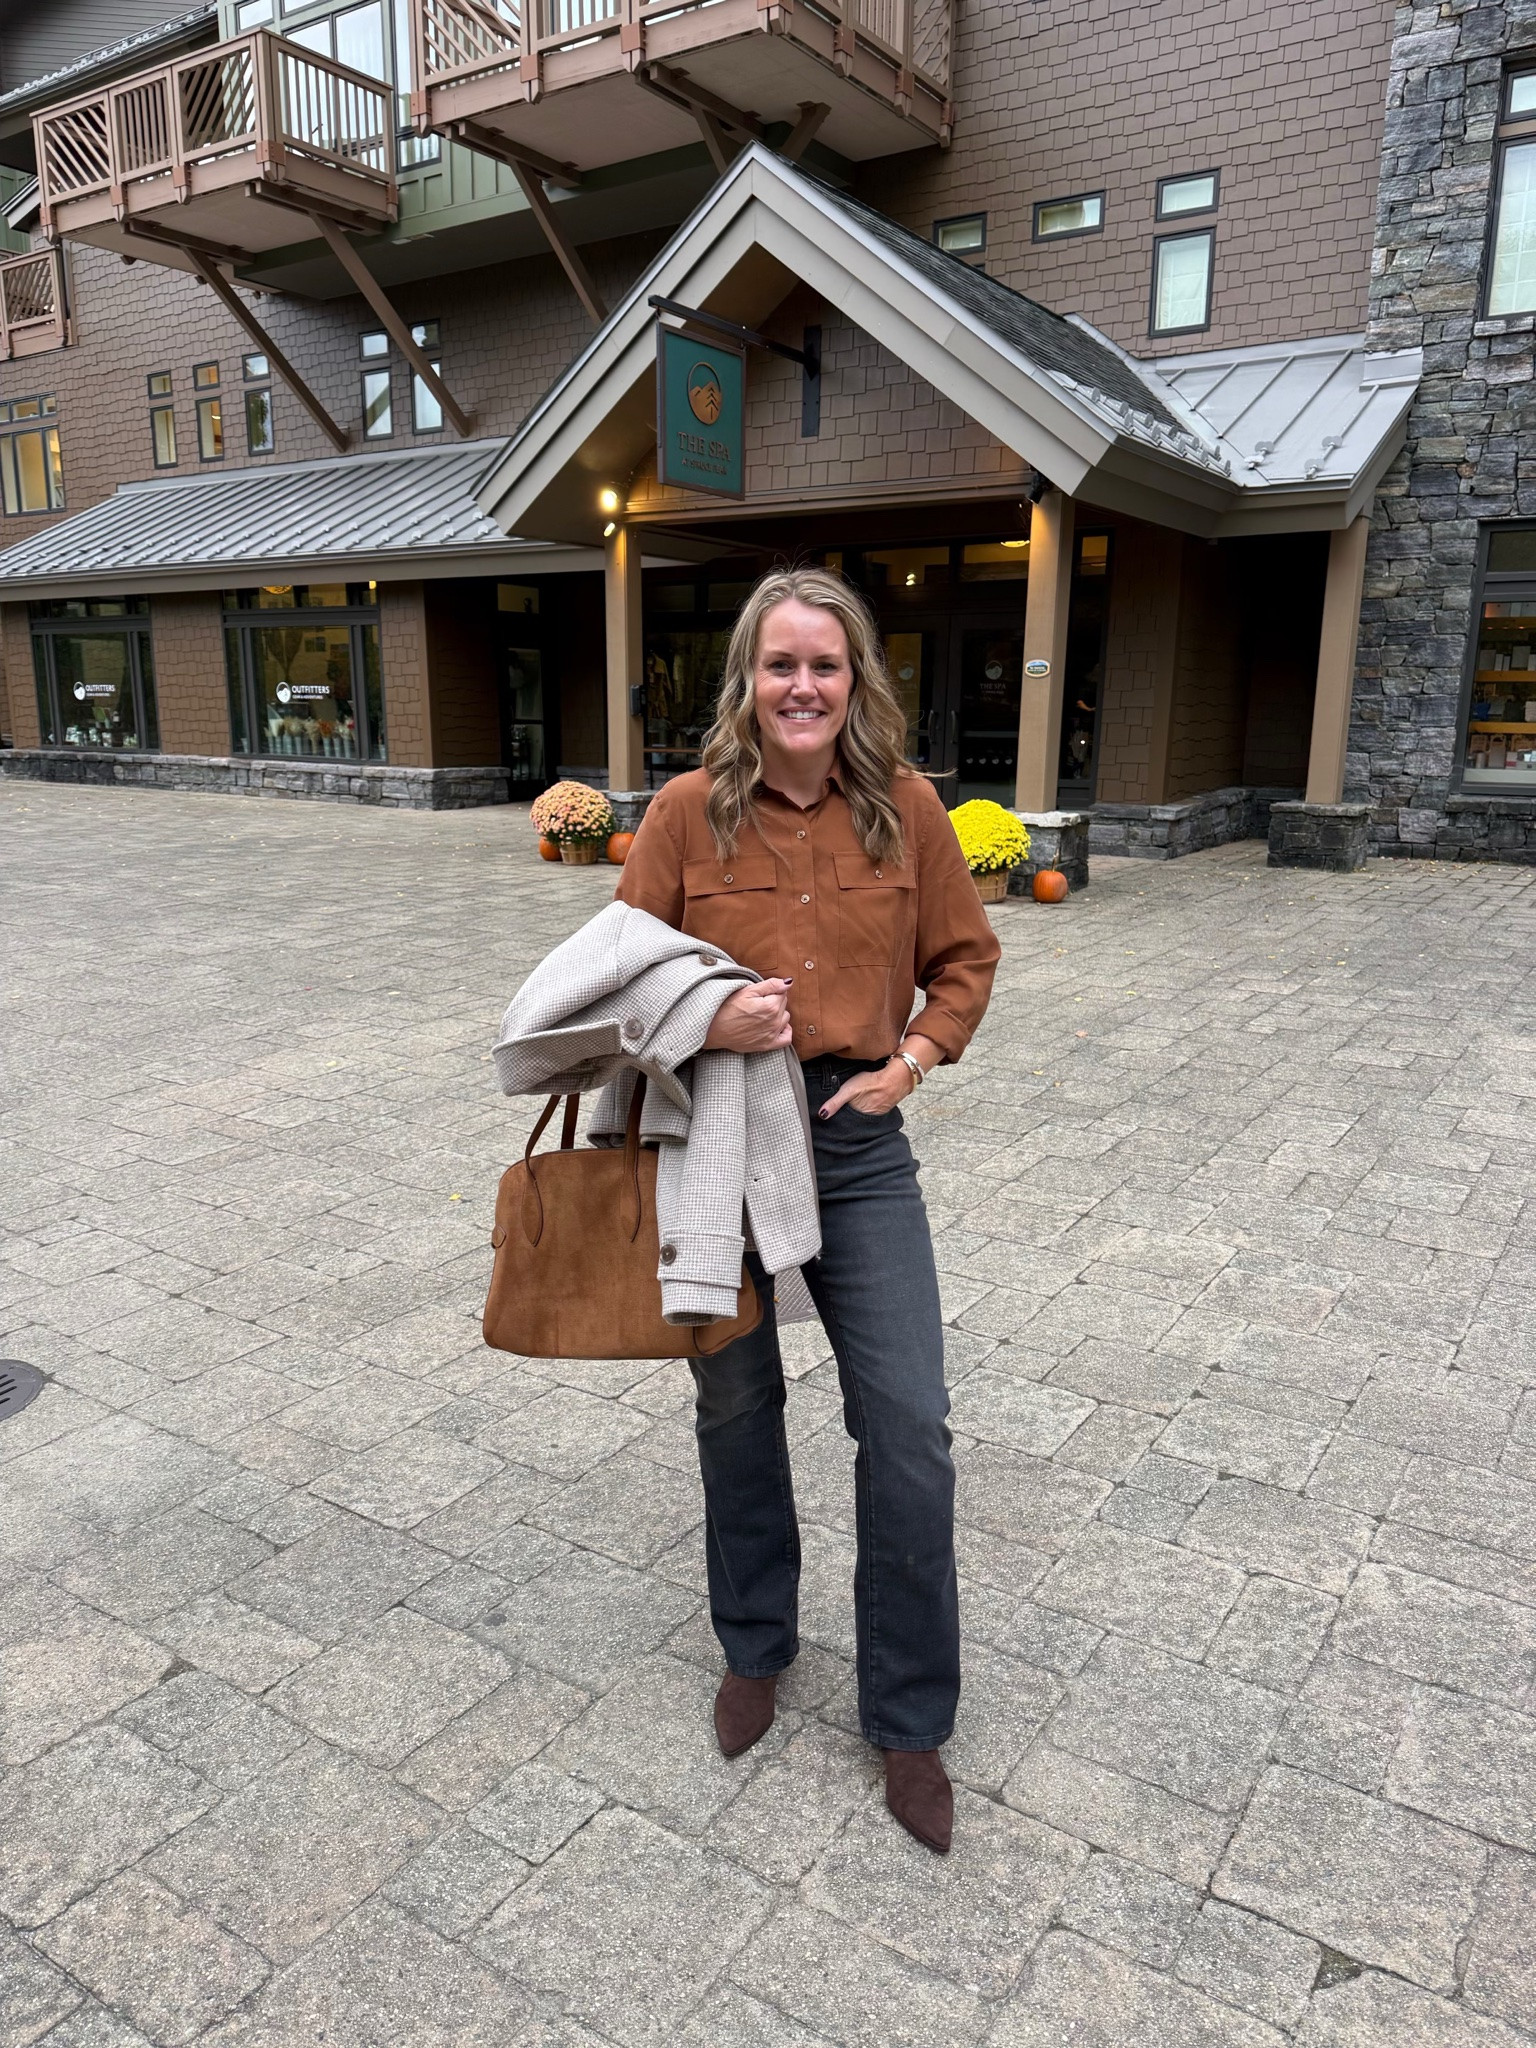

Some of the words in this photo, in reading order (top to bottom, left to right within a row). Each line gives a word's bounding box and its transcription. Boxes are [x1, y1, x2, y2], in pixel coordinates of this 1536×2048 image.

[677, 431, 705, 456] THE
[708, 440, 731, 462] SPA
[85, 684, 116, 692] OUTFITTERS
[291, 685, 330, 694] OUTFITTERS
